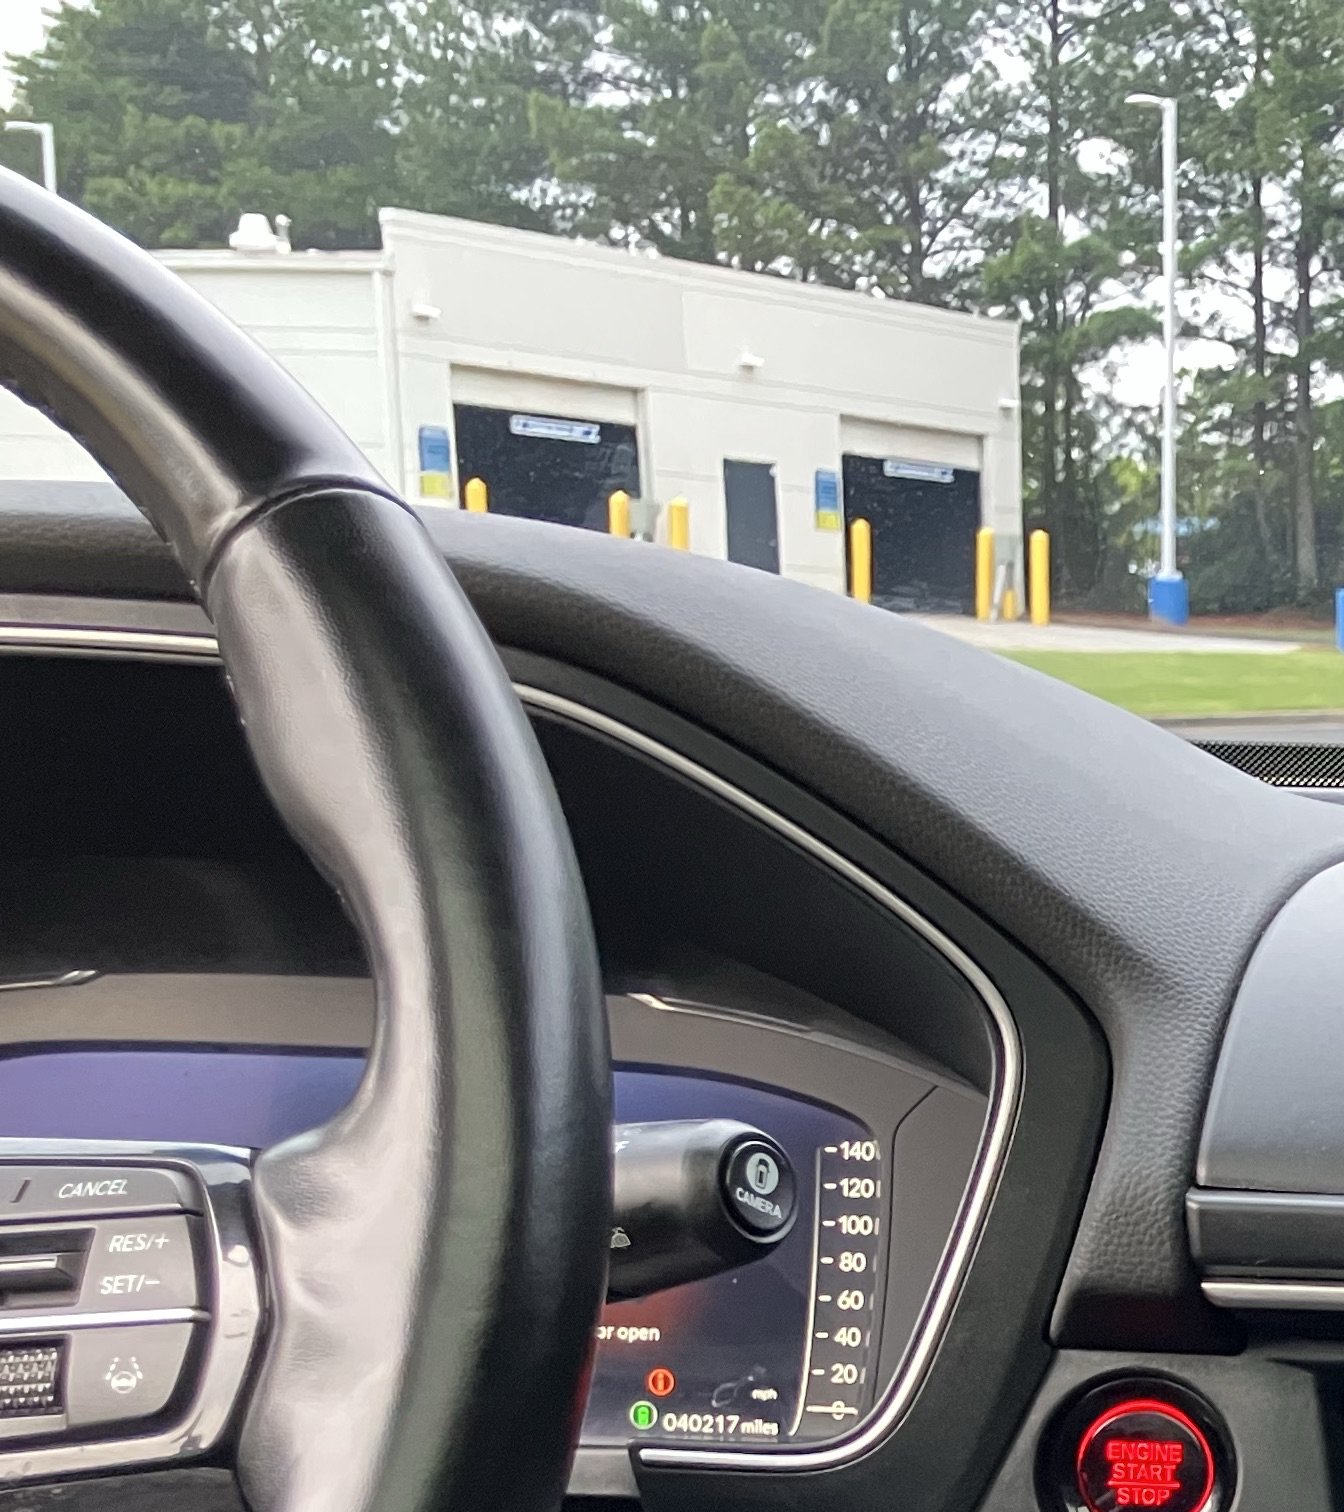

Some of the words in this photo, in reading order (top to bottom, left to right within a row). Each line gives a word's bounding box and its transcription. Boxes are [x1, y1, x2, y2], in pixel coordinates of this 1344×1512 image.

[840, 1141, 874, 1161] 140
[58, 1179, 128, 1199] CANCEL
[839, 1178, 874, 1198] 120
[736, 1187, 783, 1219] CAMERA
[839, 1215, 873, 1235] 100
[108, 1234, 170, 1252] RES/+
[839, 1252, 866, 1272] 80
[837, 1290, 864, 1310] 60
[597, 1325, 615, 1340] or
[617, 1326, 661, 1343] open
[834, 1326, 861, 1347] 40
[831, 1363, 858, 1384] 20
[663, 1413, 740, 1434] 040217
[741, 1419, 778, 1435] miles
[1106, 1441, 1183, 1462] ENGINE
[1112, 1463, 1177, 1482] START
[1117, 1488, 1170, 1505] STOP
